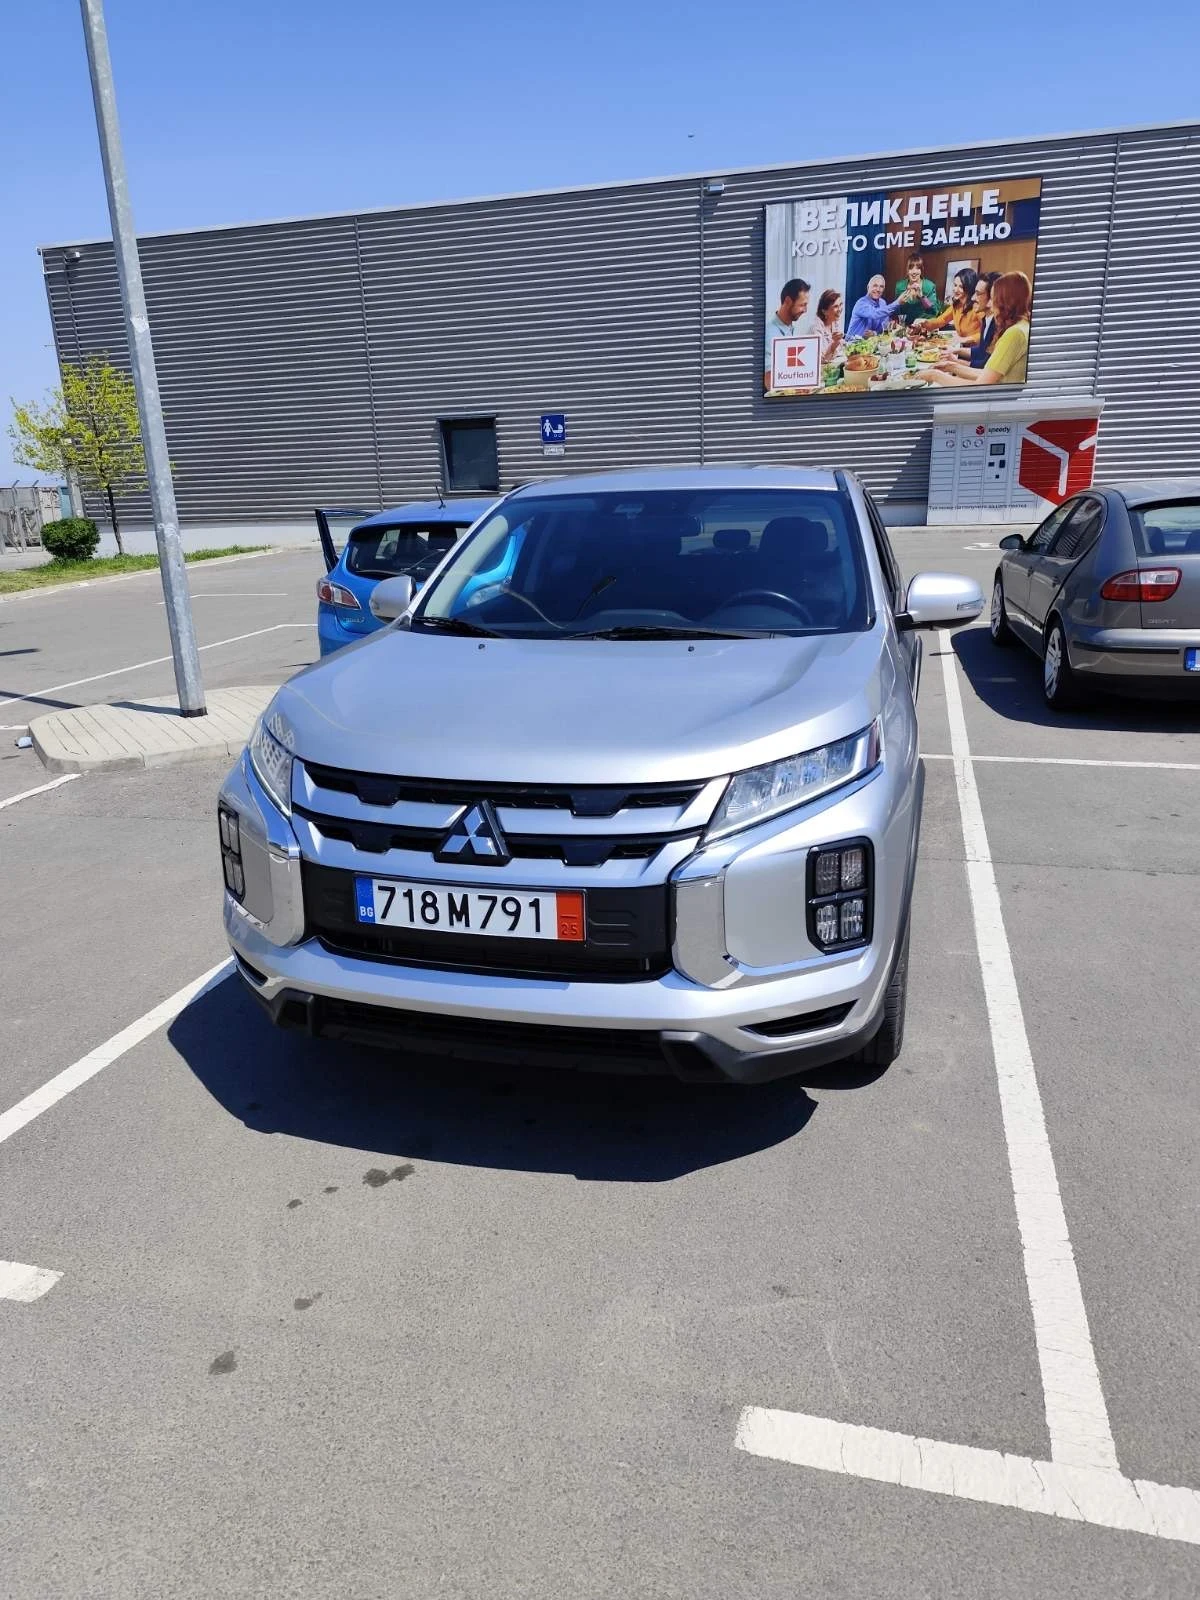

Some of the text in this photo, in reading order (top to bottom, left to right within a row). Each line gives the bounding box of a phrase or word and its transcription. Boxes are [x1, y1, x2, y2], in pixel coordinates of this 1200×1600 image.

[801, 188, 1004, 232] ВЕЛИКДЕН Е,
[791, 222, 1011, 257] КОГАТО СМЕ ЗАЕДНО
[777, 370, 814, 380] Kaufland
[359, 905, 374, 918] BG
[560, 922, 578, 936] 25
